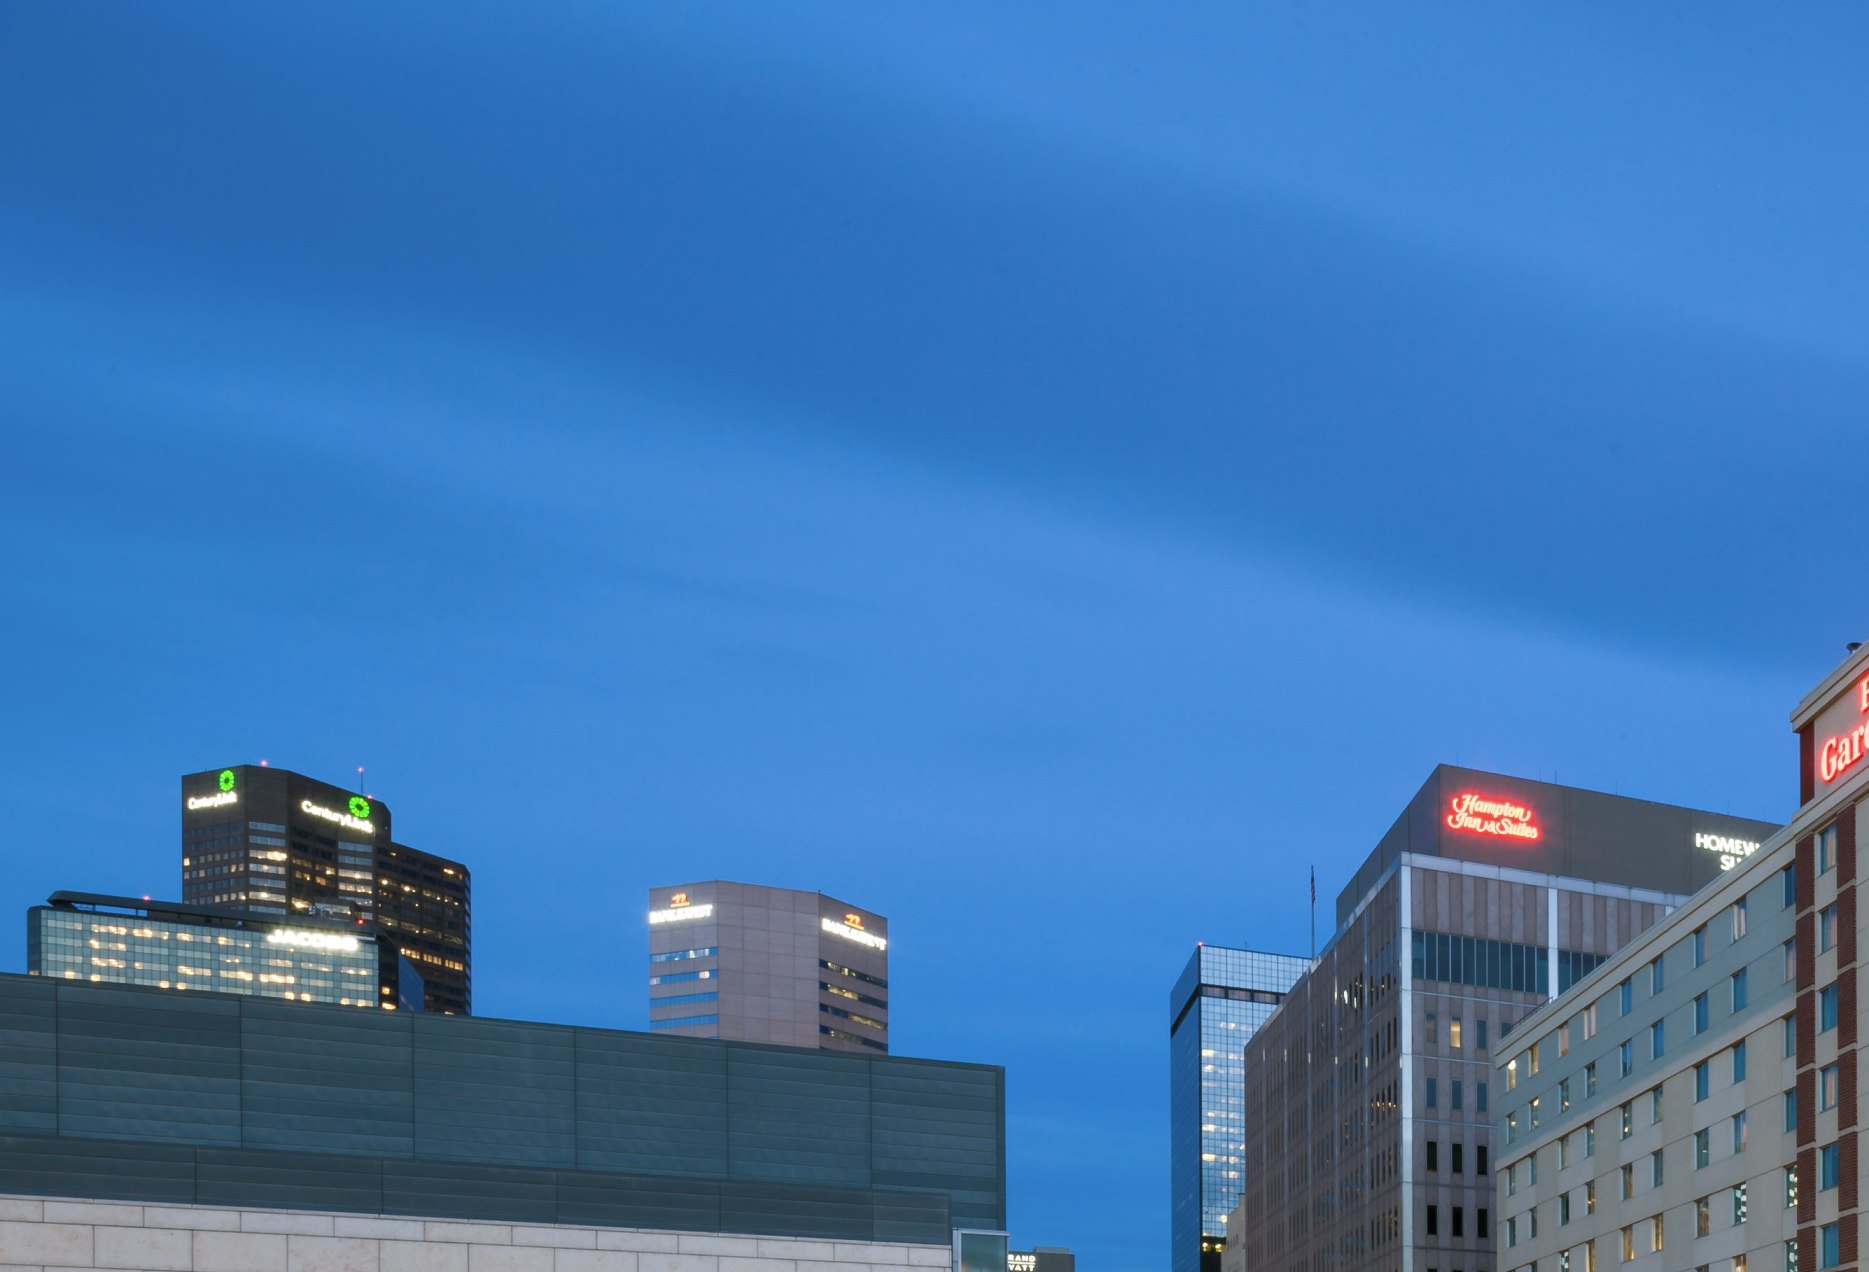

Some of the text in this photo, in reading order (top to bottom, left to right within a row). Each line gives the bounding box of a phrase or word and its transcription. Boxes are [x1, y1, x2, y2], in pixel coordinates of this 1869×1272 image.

[301, 800, 374, 834] CenturyLink
[1453, 795, 1531, 822] Hampton
[1447, 812, 1488, 832] Inn
[1496, 818, 1538, 839] Suites
